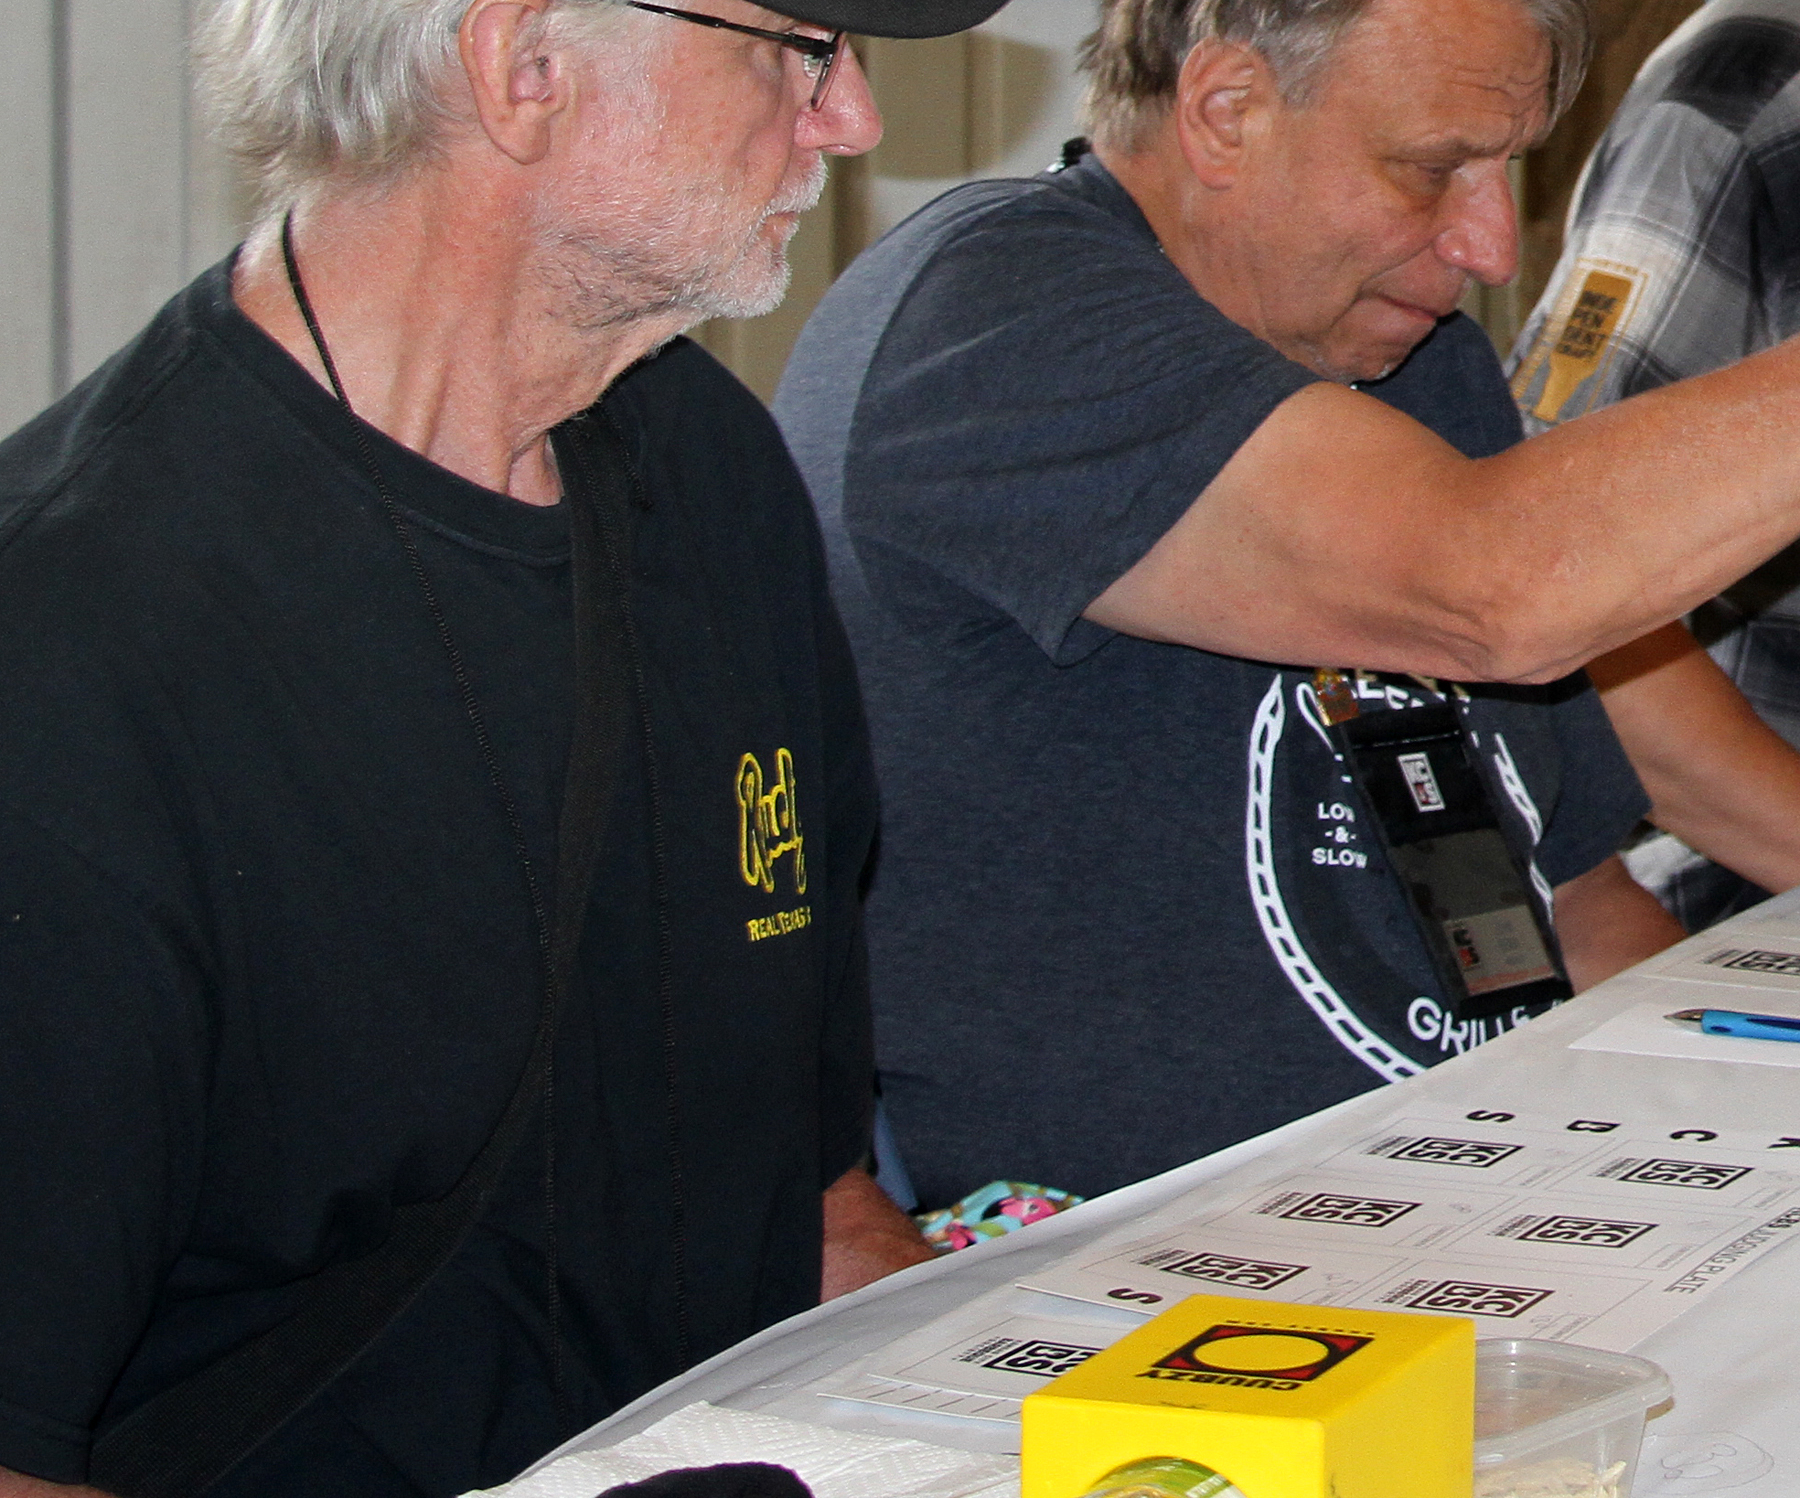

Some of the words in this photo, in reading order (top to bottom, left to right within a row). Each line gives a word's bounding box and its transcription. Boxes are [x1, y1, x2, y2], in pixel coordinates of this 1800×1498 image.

[1312, 847, 1367, 869] SLOW
[1466, 1110, 1515, 1123] S
[1566, 1119, 1622, 1133] B
[1669, 1129, 1719, 1142] C
[1672, 1264, 1726, 1294] PLATE
[1107, 1288, 1164, 1304] S
[997, 1345, 1078, 1370] BS
